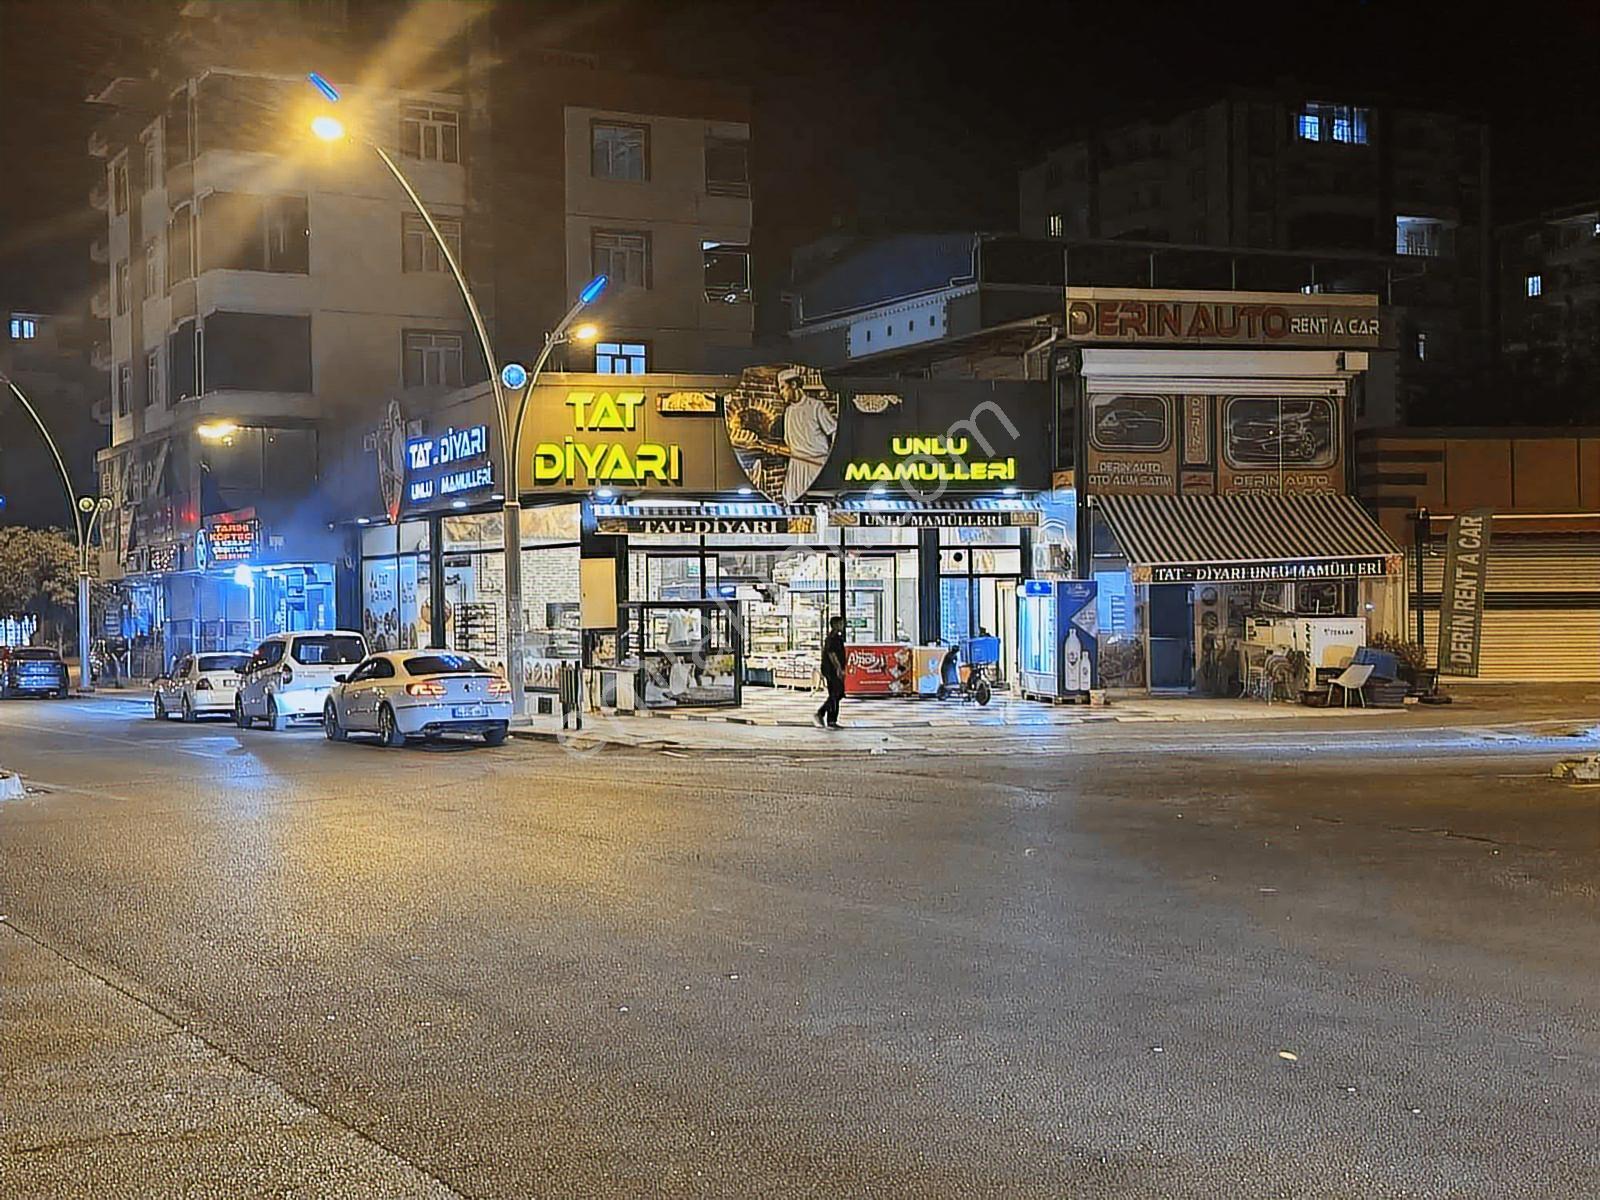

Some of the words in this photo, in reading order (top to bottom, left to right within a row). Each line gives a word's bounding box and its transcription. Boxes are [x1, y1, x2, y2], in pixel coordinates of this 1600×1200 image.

[1187, 304, 1289, 338] AUTO
[1291, 317, 1328, 333] RENT
[1333, 319, 1345, 334] A
[1349, 319, 1379, 335] CAR
[565, 392, 646, 430] TAT
[535, 436, 681, 481] DİYARI
[892, 437, 967, 455] UNLU
[845, 458, 1015, 480] MAMULLERİ
[1458, 515, 1484, 549] CAR
[1156, 568, 1183, 581] TAT
[1196, 566, 1246, 580] DİYARI
[1457, 553, 1480, 565] A
[1453, 567, 1479, 611] RENT
